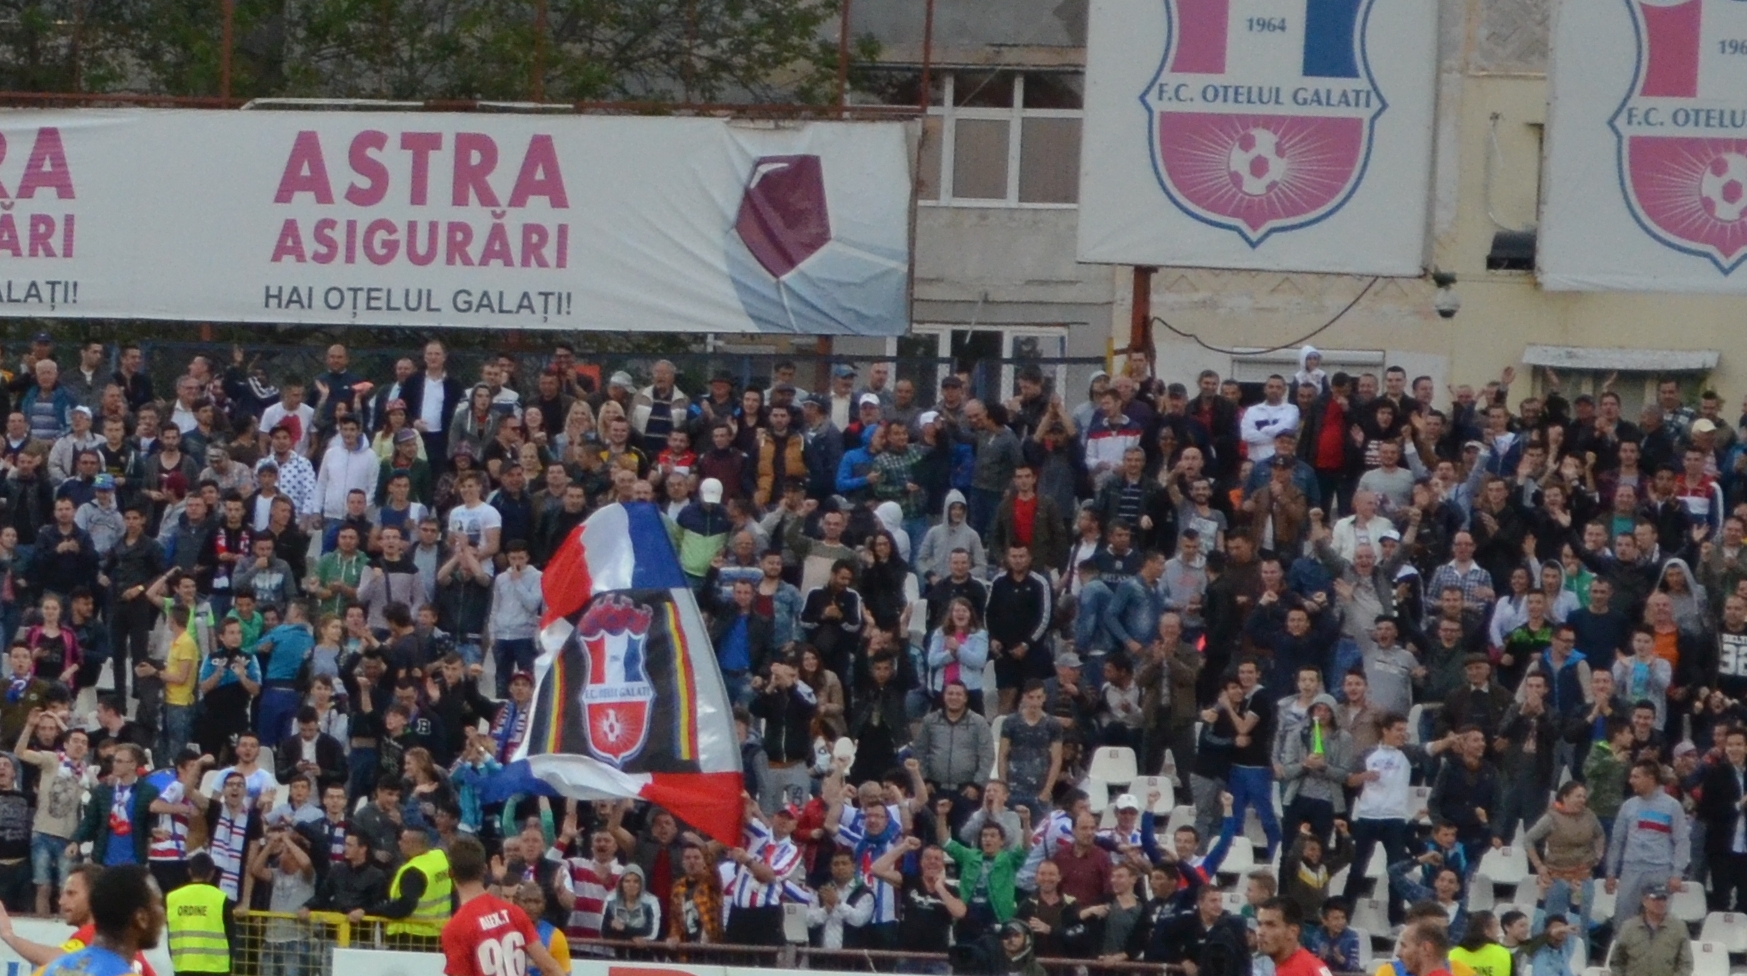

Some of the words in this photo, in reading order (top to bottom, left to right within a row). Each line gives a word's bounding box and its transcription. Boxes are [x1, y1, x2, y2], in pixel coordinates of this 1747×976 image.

[1247, 17, 1287, 33] 1964
[1158, 83, 1194, 102] F.C.
[1202, 84, 1283, 105] OTELUL
[1292, 87, 1371, 108] GALATI
[1627, 107, 1664, 126] F.C.
[274, 130, 569, 209] ASTRA
[271, 210, 569, 269] ASIGURĂRI
[264, 286, 313, 309] HAI
[323, 287, 441, 319] OȚELUL
[452, 289, 572, 323] GALAȚI!
[177, 905, 208, 917] ORDINE
